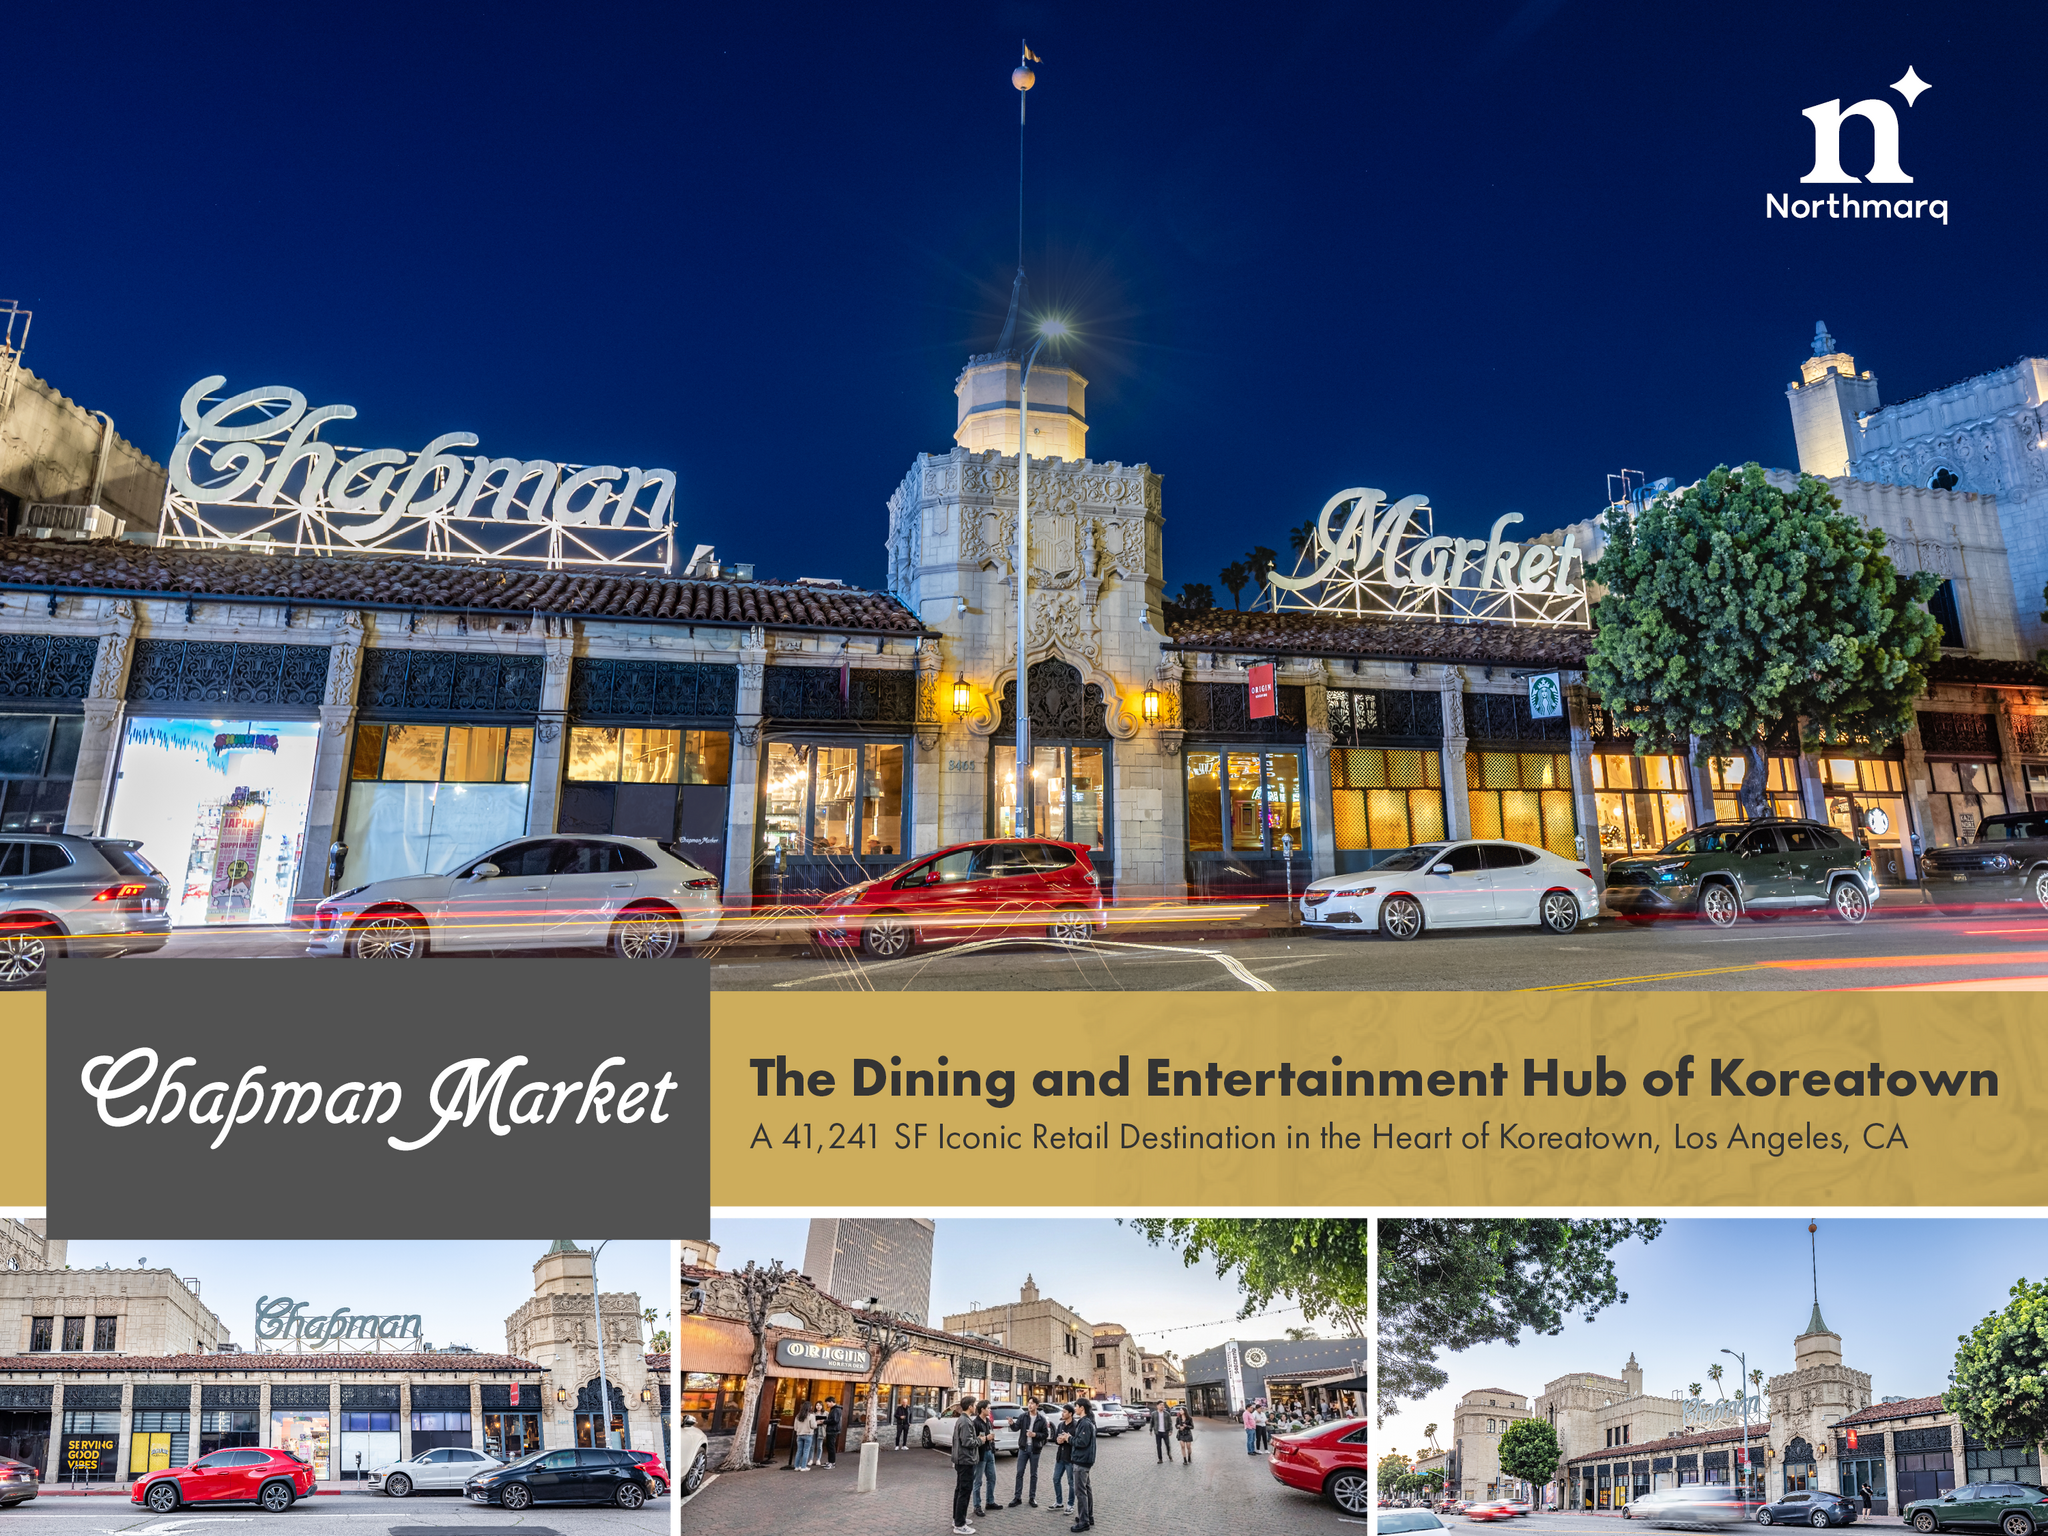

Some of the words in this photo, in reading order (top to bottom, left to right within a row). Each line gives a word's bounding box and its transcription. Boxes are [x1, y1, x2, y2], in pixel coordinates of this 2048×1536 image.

[169, 374, 676, 541] Chapman
[1268, 487, 1581, 595] Market
[1251, 684, 1271, 694] ORIGIN
[948, 760, 975, 771] 3465
[223, 818, 255, 828] JAPAN
[255, 1295, 421, 1348] Chapman
[787, 1343, 866, 1363] ORIGIN
[1682, 1395, 1760, 1430] Chapman
[68, 1440, 114, 1450] SERVING
[68, 1450, 99, 1460] GOOD
[67, 1460, 97, 1470] VIBES
